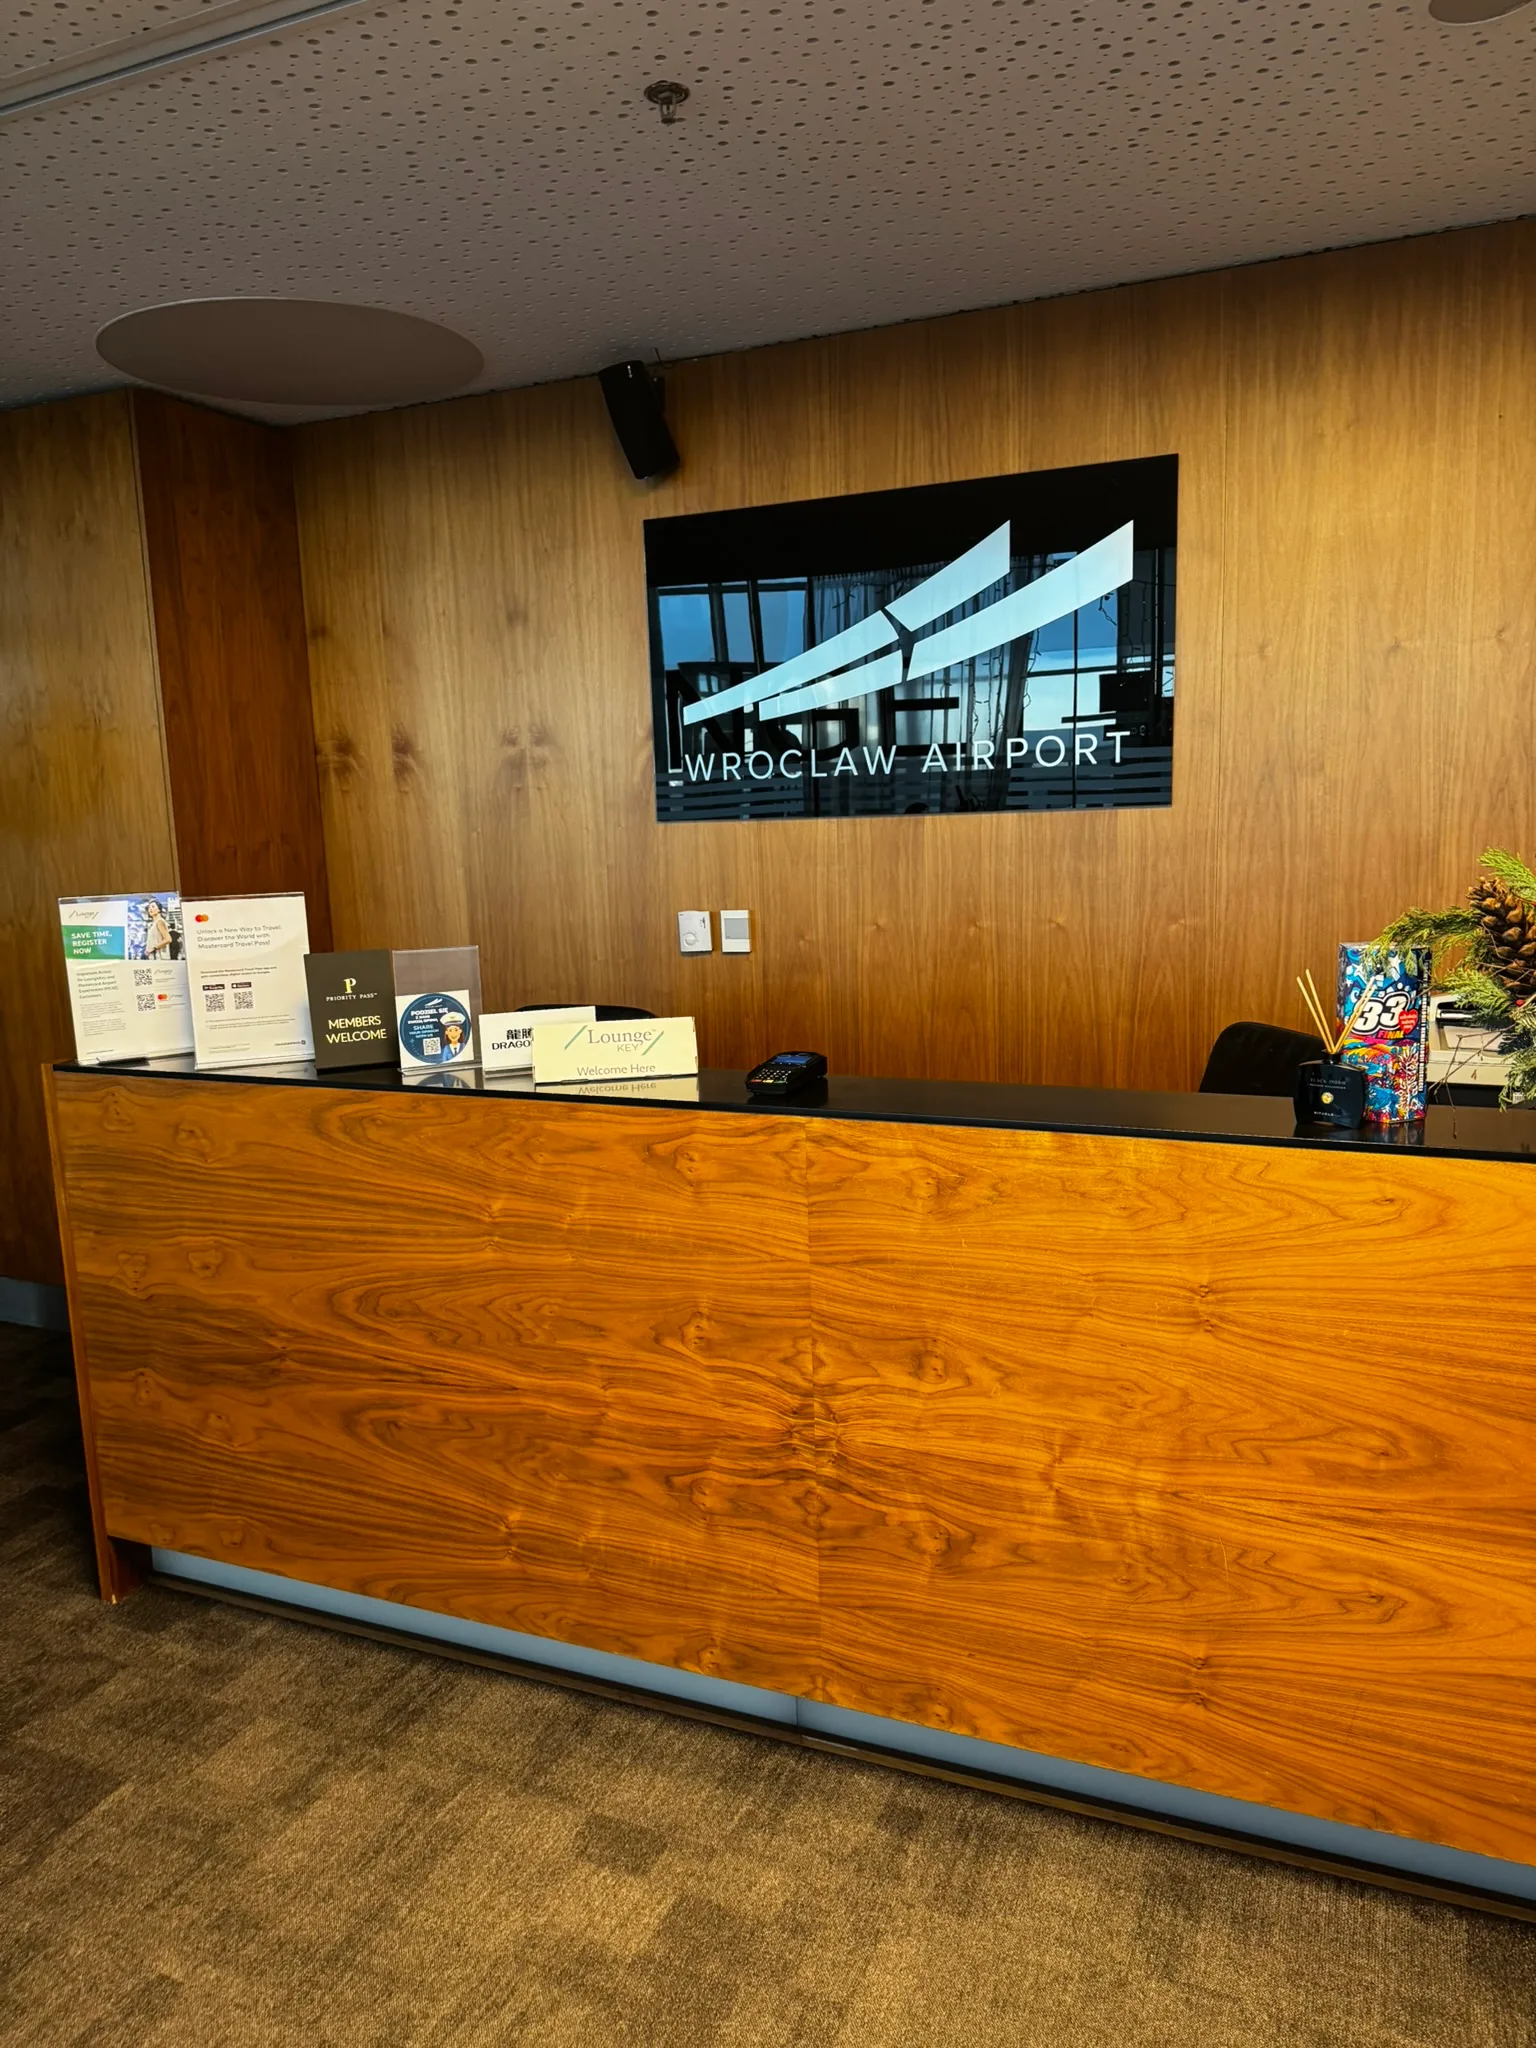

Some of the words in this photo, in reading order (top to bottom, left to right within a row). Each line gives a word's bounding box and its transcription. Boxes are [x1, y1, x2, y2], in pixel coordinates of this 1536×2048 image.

[685, 744, 897, 781] WROCLAW
[922, 731, 1131, 773] AIRPORT
[72, 939, 107, 947] REGISTER
[73, 947, 91, 955] NOW
[343, 978, 357, 994] P
[1353, 992, 1409, 1033] 33
[328, 1015, 381, 1030] MEMBERS
[326, 1029, 387, 1044] WELCOME
[588, 1029, 652, 1046] Lounge
[1377, 1031, 1404, 1039] FINAL
[492, 1040, 532, 1050] DRAGO
[617, 1044, 639, 1052] KEY
[577, 1066, 628, 1077] Welcome
[630, 1064, 656, 1073] Here
